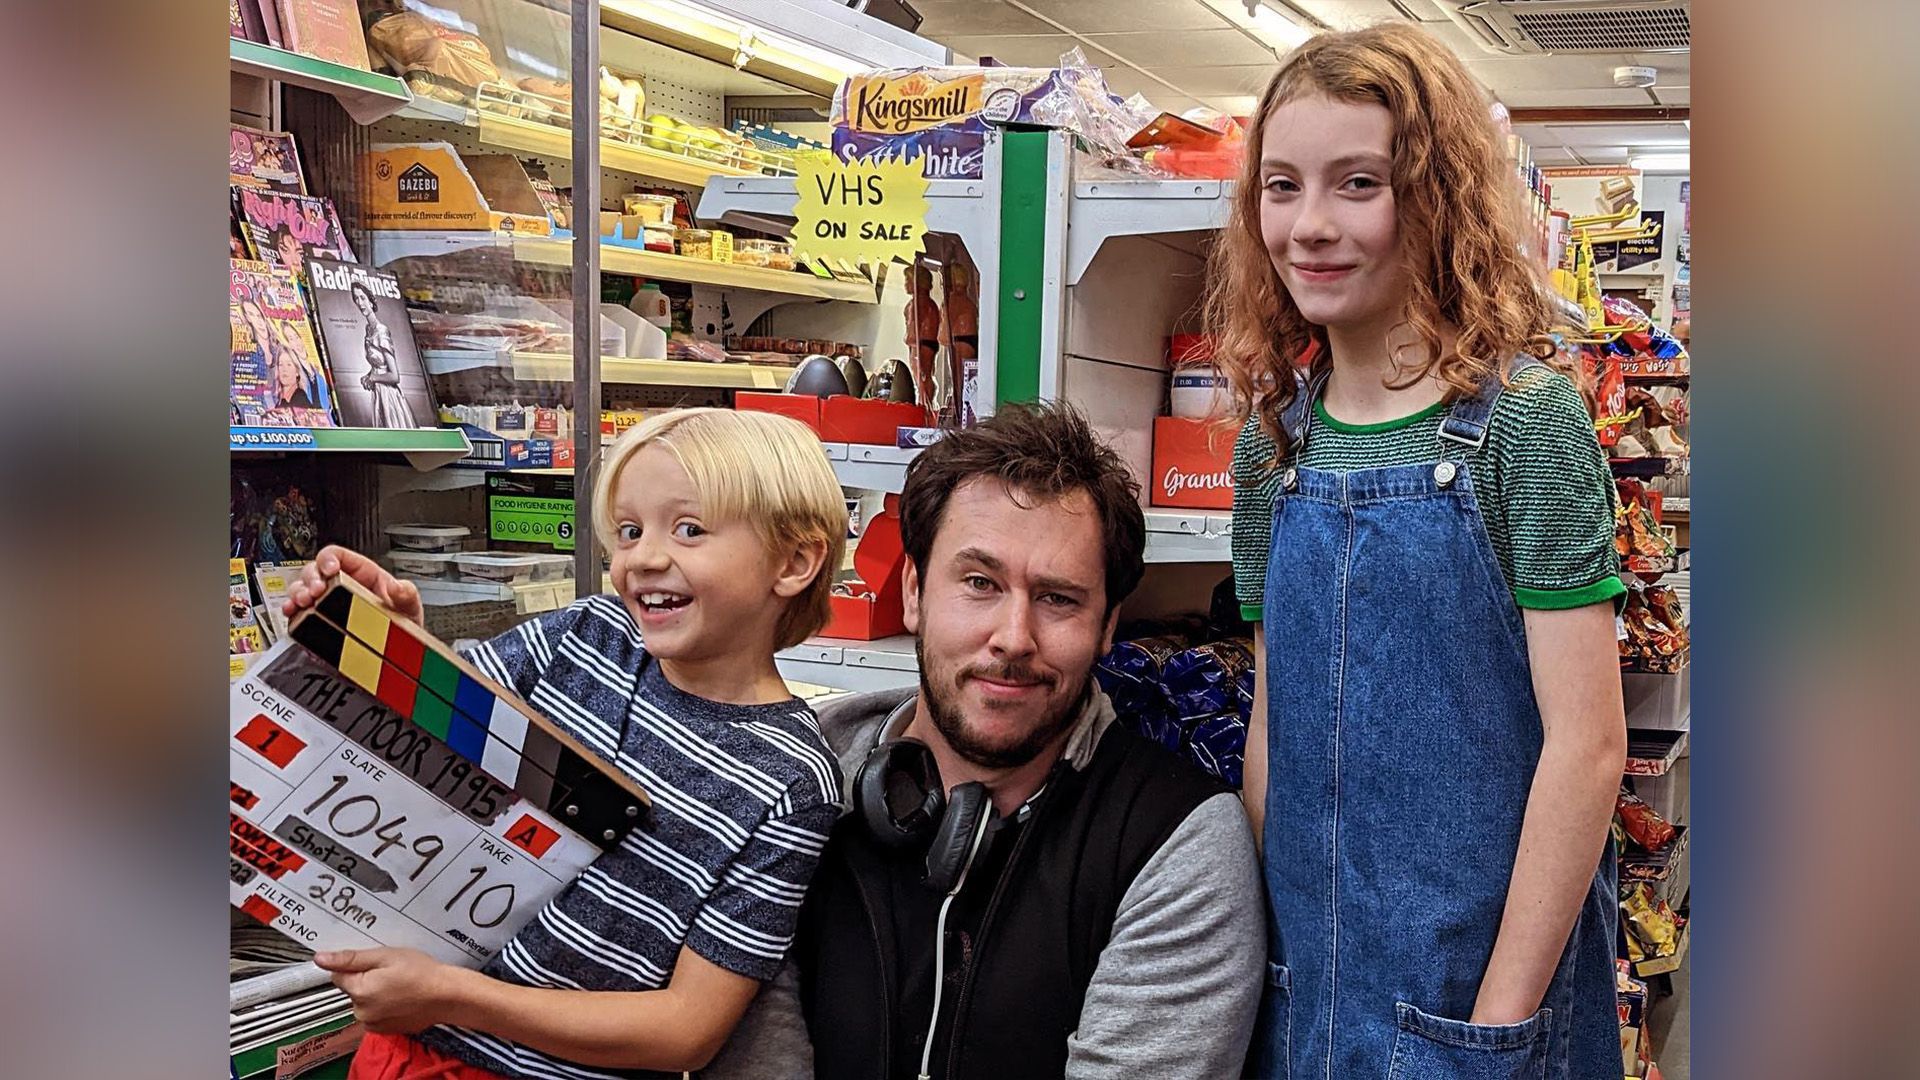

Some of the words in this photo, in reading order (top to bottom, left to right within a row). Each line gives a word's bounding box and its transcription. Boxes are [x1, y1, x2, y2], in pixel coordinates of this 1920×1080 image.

[856, 83, 968, 132] Kingsmill
[400, 178, 437, 191] GAZEBO
[815, 172, 884, 206] VHS
[444, 212, 477, 221] discovery!
[815, 219, 847, 239] ON
[859, 221, 912, 241] SALE
[1621, 246, 1642, 255] utility
[616, 417, 637, 426] £1.25
[230, 433, 244, 445] up
[246, 432, 260, 443] to
[495, 499, 516, 508] FOOD
[517, 501, 546, 510] HYGIENE
[547, 502, 573, 511] RATING
[561, 523, 570, 538] 5
[241, 683, 296, 722] SCENE
[257, 729, 282, 753] 1
[294, 673, 356, 723] THE
[347, 704, 432, 777] MOOR
[426, 754, 507, 818] 1995
[341, 749, 387, 781] SLATE
[303, 775, 444, 882] 1049
[511, 825, 538, 847] A
[288, 825, 341, 863] Shot
[337, 856, 357, 878] 2
[479, 838, 513, 865] TAKE
[256, 882, 305, 915] FILTER
[308, 873, 377, 931] 28mm
[444, 866, 515, 928] 10
[278, 914, 318, 941] SYNC
[465, 938, 491, 957] Rental
